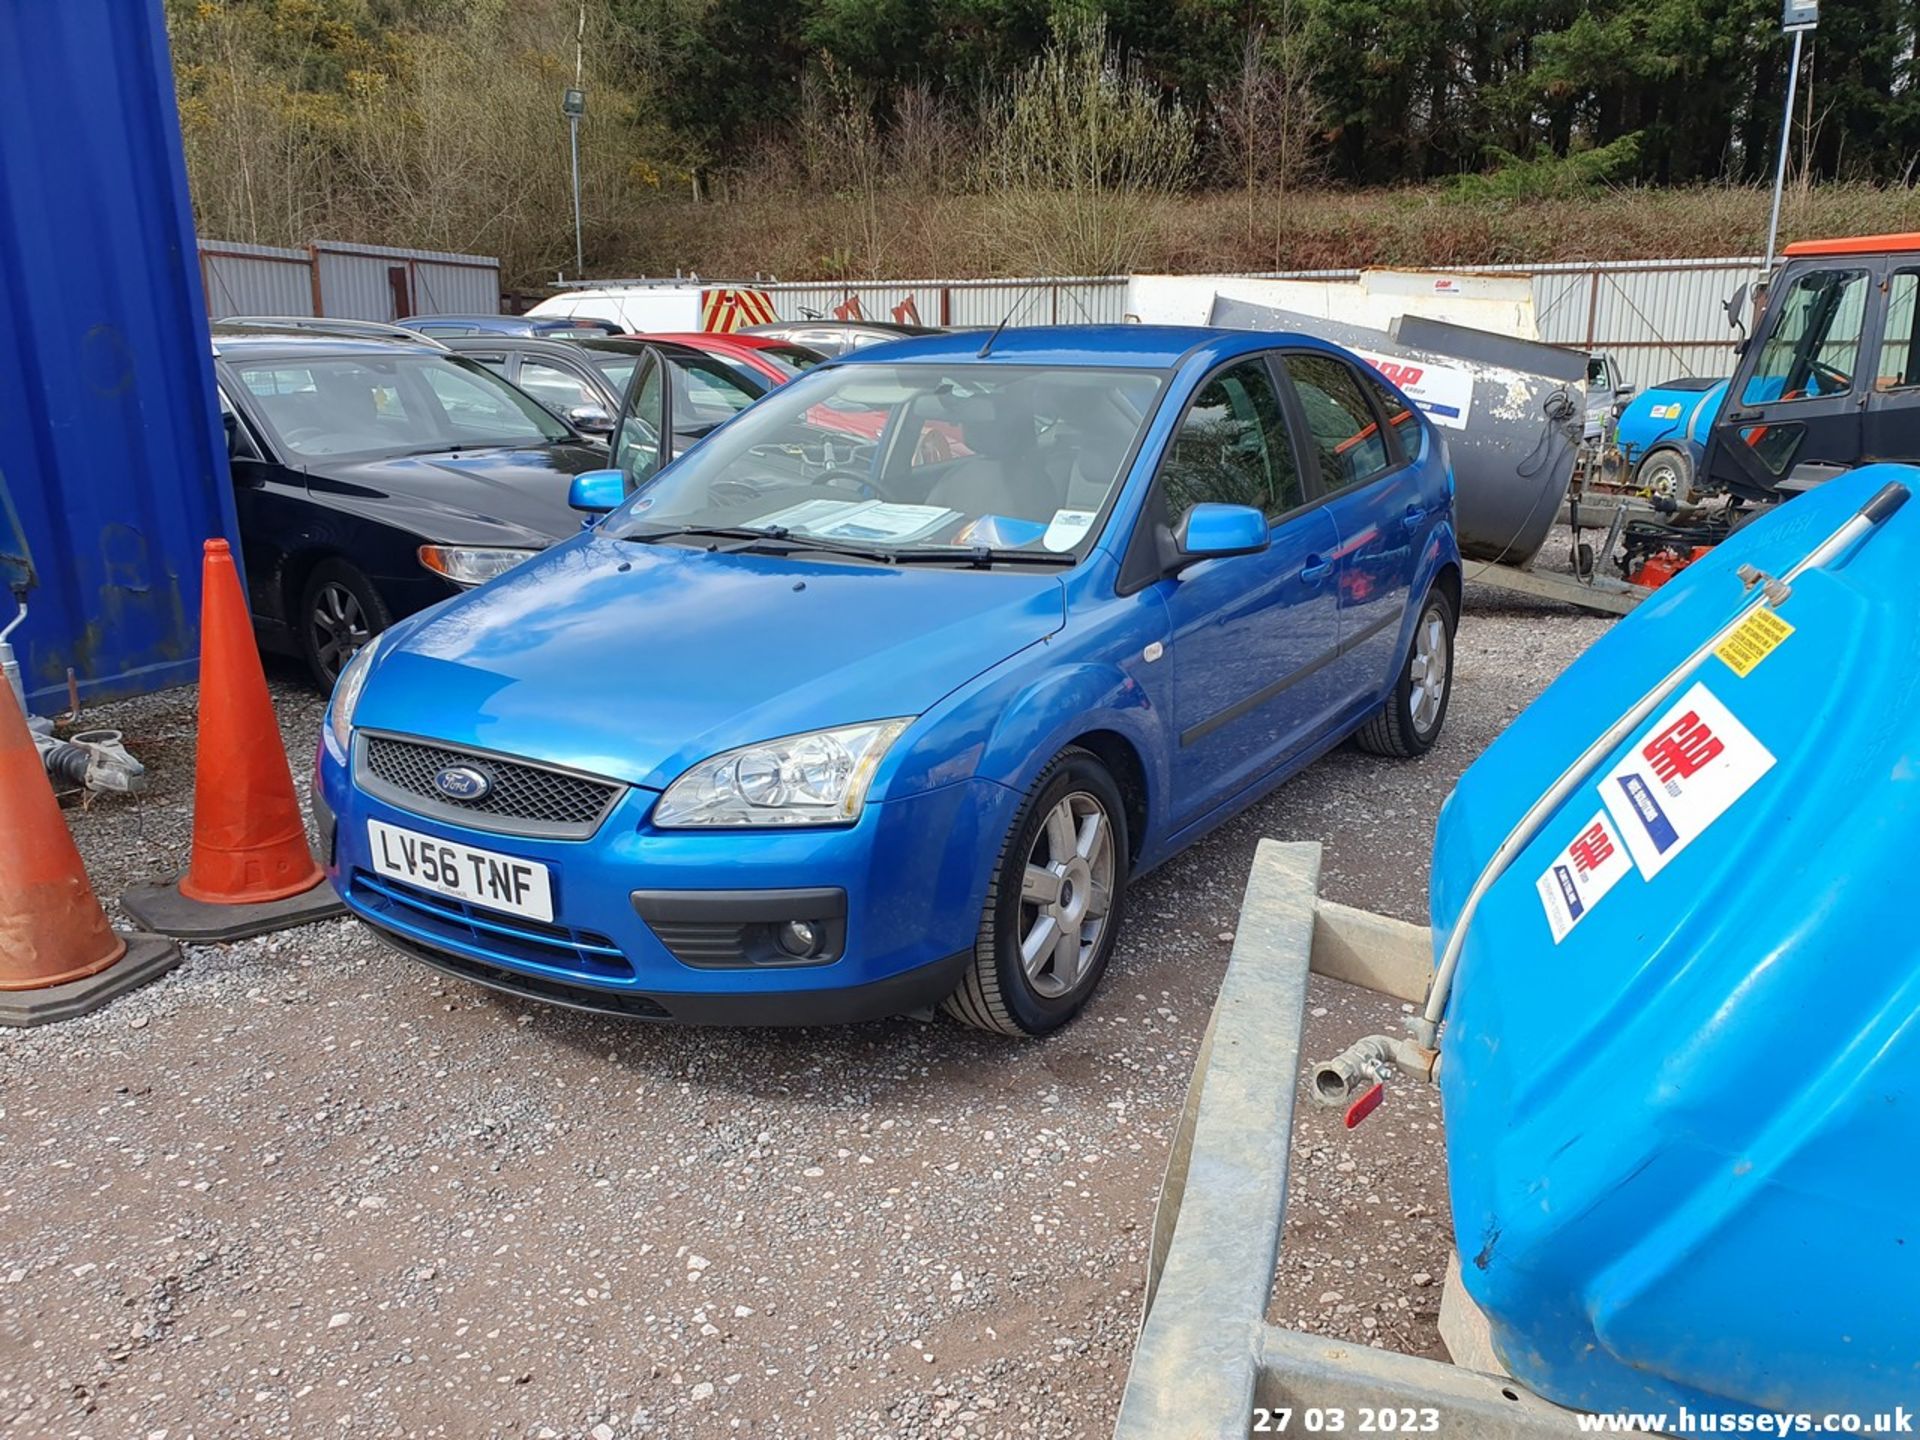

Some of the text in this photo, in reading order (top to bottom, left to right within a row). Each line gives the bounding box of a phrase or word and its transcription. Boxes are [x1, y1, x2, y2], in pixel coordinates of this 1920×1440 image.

[1642, 710, 1725, 785] GAP
[442, 772, 469, 792] Ford
[1665, 780, 1682, 798] GROUP
[380, 830, 532, 905] LV56 TNF
[1569, 822, 1615, 873] GAP
